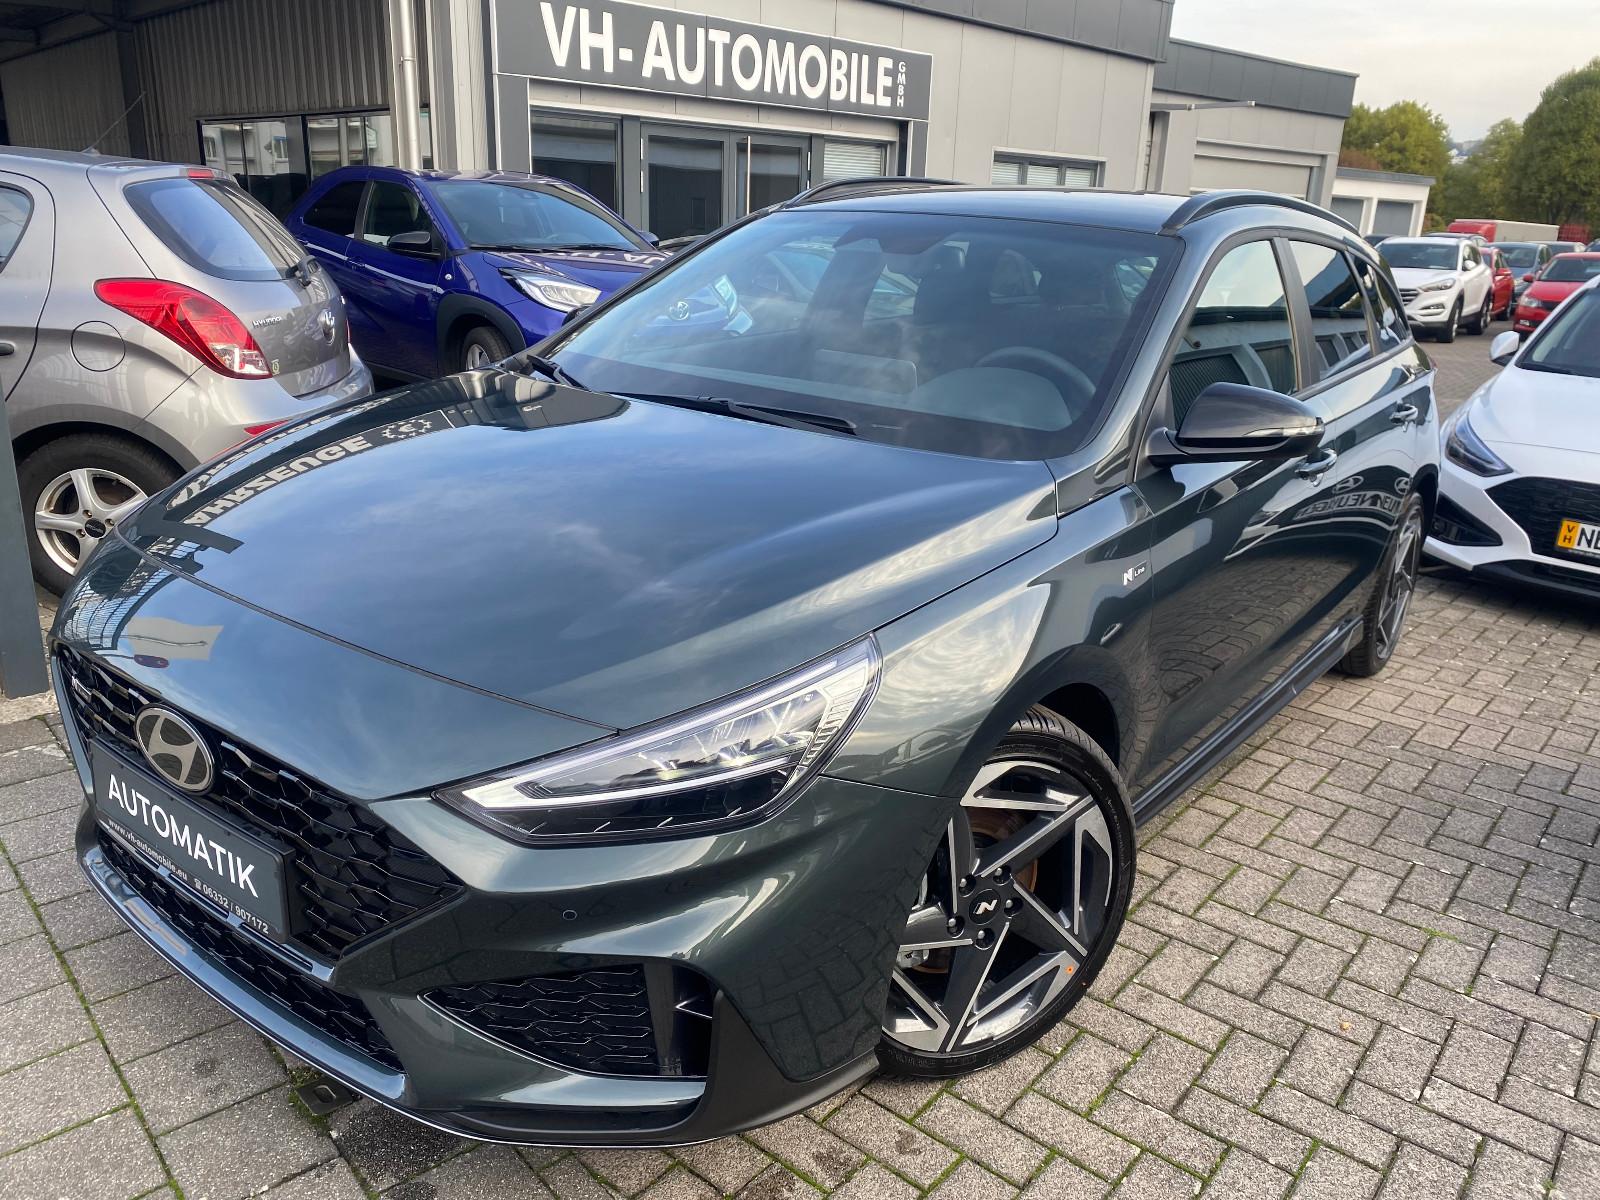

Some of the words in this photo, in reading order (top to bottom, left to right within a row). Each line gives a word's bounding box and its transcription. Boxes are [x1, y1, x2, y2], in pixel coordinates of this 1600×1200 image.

[108, 774, 258, 898] AUTOMATIK
[108, 819, 188, 882] www.vh-automobile.eu
[202, 884, 230, 908] 06332
[235, 905, 269, 934] 907172
